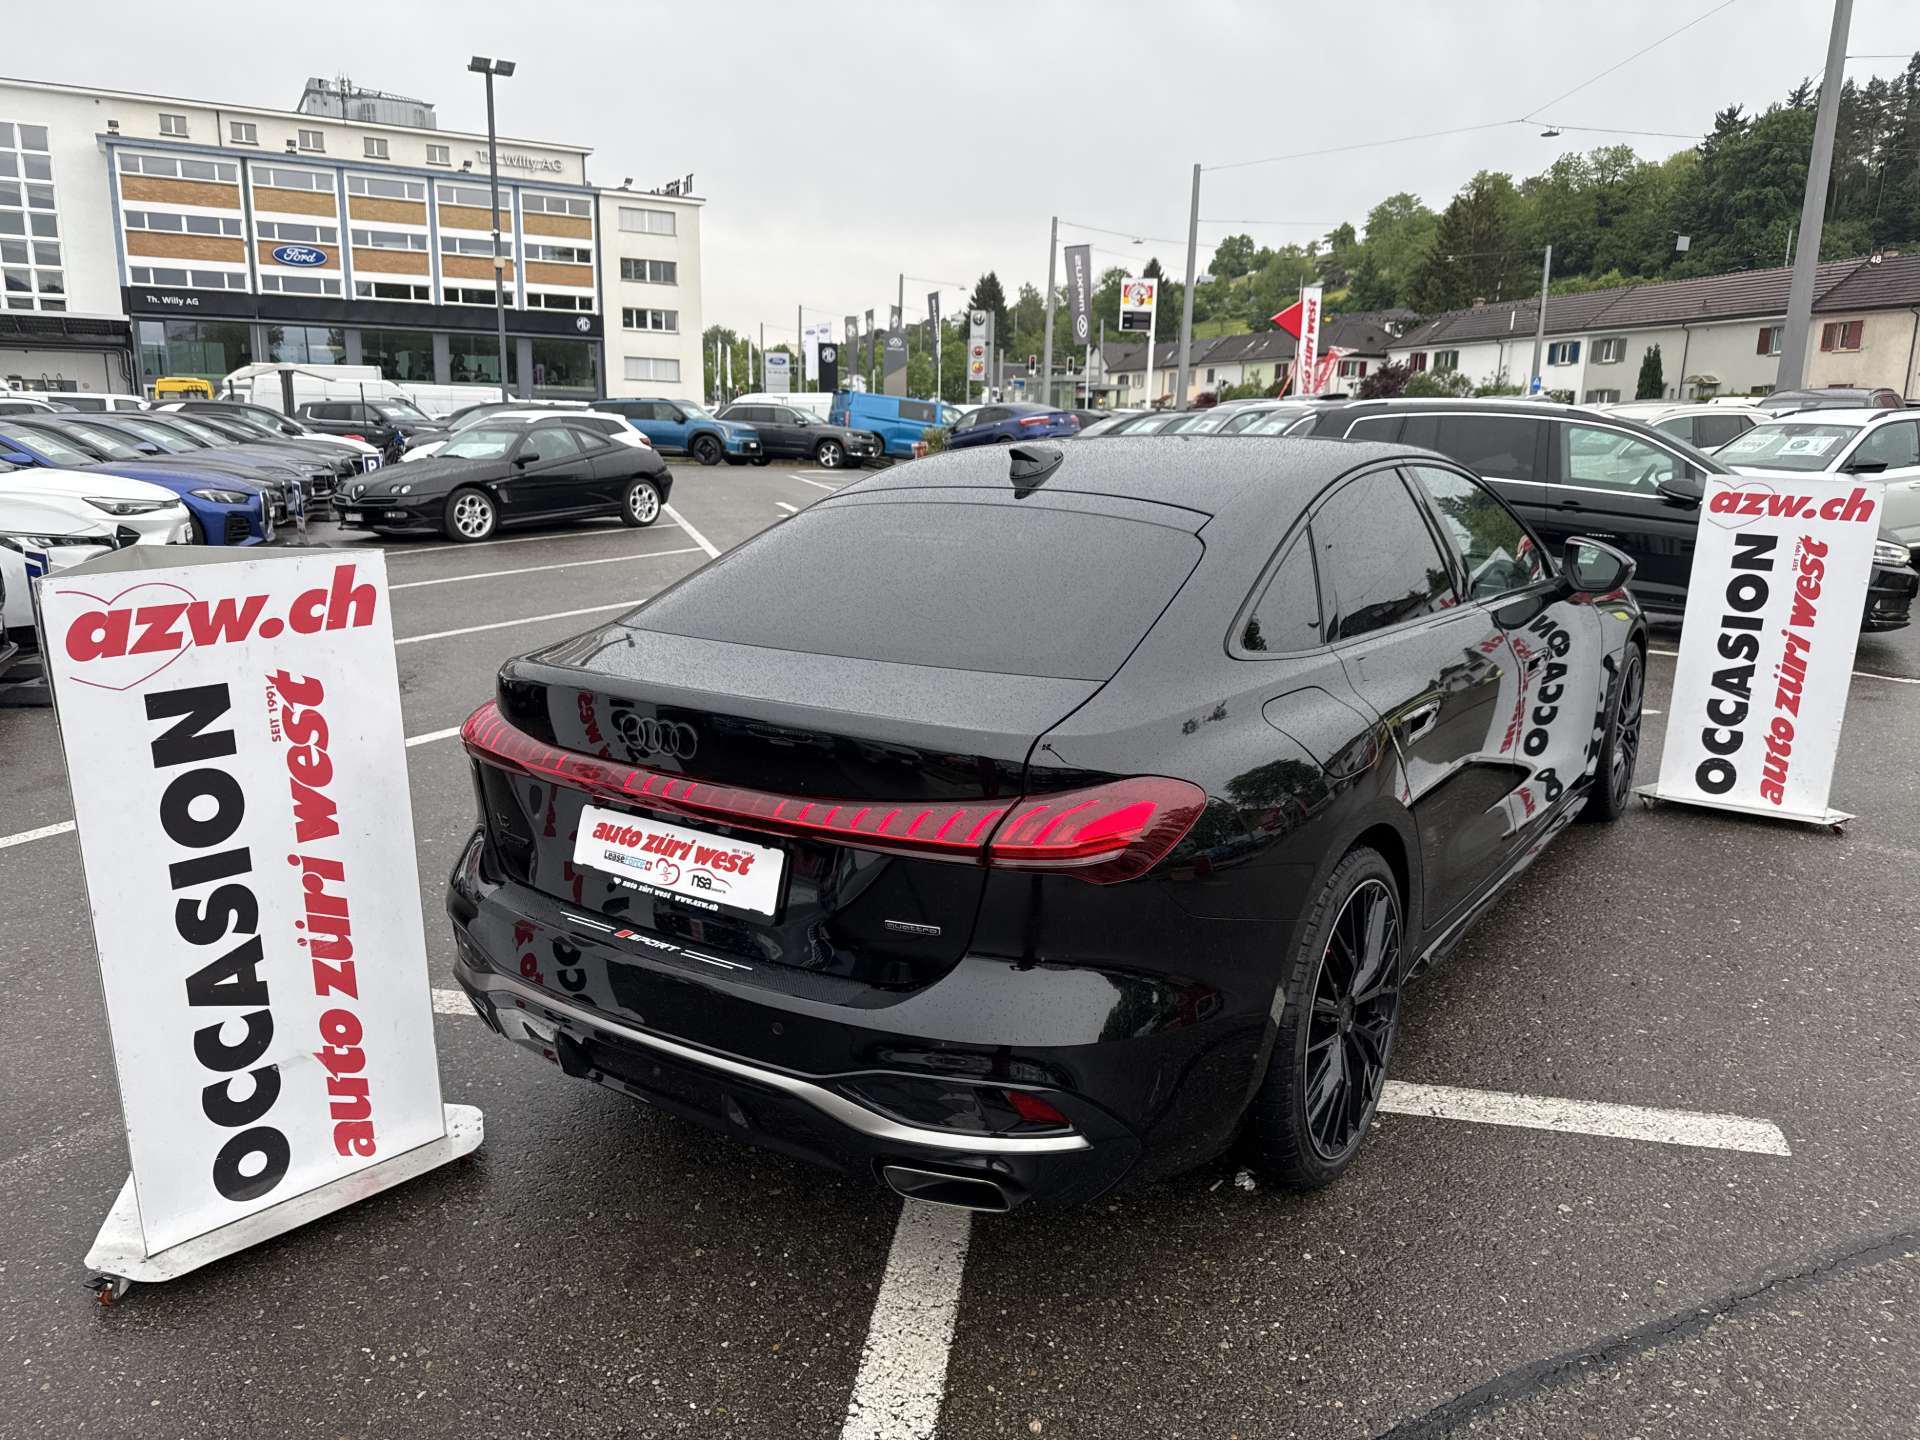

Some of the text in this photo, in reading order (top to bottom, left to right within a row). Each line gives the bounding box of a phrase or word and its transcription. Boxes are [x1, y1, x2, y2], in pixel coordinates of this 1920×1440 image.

[503, 152, 538, 173] Willy
[542, 158, 563, 173] AG
[281, 246, 319, 265] Ford
[1870, 255, 1882, 263] 48
[146, 295, 200, 307] Th. Willy AG
[368, 459, 377, 472] P
[1709, 488, 1875, 522] azw.ch
[1791, 557, 1799, 572] SEIT
[65, 563, 376, 662] azw.ch
[1695, 533, 1778, 795] OCCASION
[1760, 534, 1829, 806] auto züri west
[265, 685, 282, 743] SEIT 1991
[592, 822, 755, 876] auto züri west
[622, 880, 638, 890] auto
[675, 894, 719, 912] www.azw.ch
[691, 874, 712, 890] nsa
[265, 669, 377, 1158] auto züri west
[143, 682, 291, 1201] OCCASION
